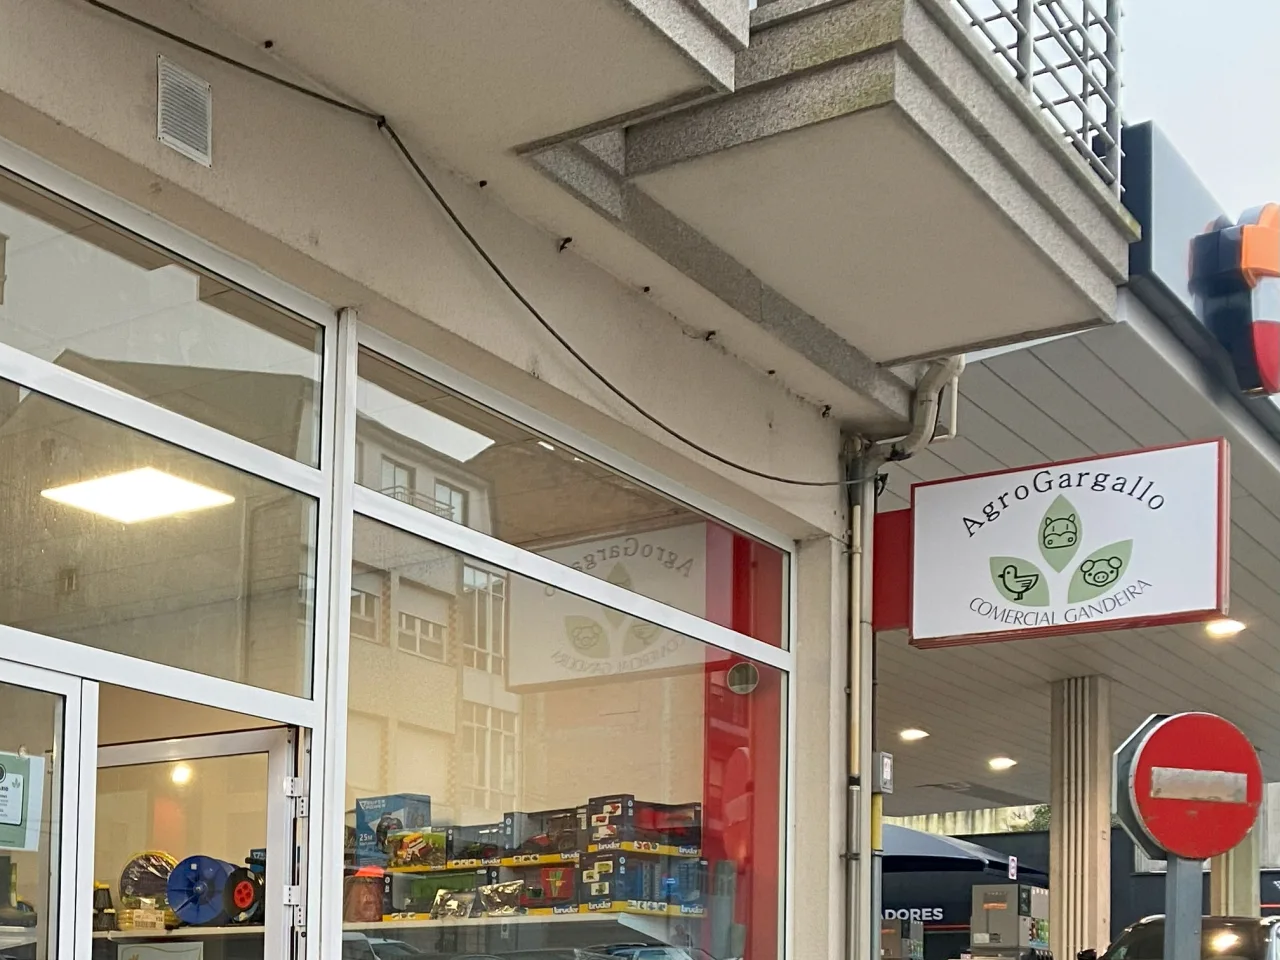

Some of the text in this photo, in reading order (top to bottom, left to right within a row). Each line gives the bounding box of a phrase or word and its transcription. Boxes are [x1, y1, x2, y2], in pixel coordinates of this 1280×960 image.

[962, 470, 1164, 538] AgroGargallo
[969, 578, 1153, 627] COMERCIAL GANDEIRA
[598, 842, 621, 850] bruder
[679, 846, 698, 855] bruder
[560, 851, 580, 860] brude
[481, 857, 502, 866] bruder
[553, 905, 579, 914] bruder
[588, 901, 612, 910] bruder
[681, 905, 704, 914] bruder
